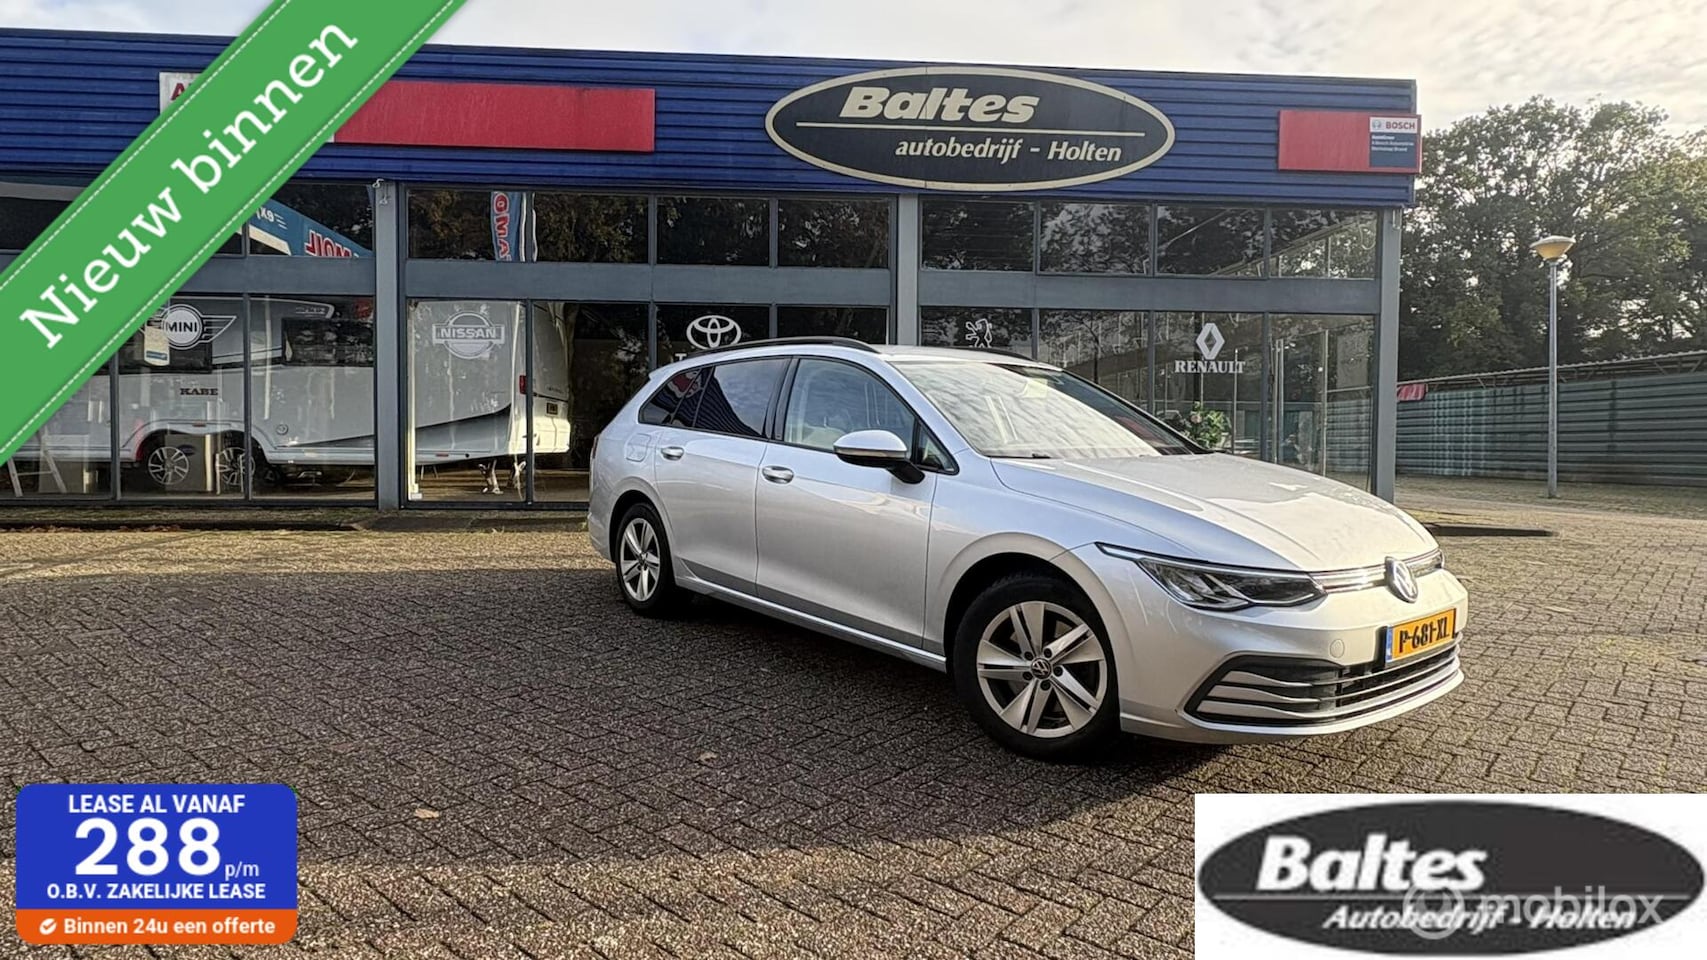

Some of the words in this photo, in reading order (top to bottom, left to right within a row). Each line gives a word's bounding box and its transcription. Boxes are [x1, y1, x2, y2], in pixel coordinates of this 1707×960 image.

[839, 87, 1040, 123] Baltes
[1385, 121, 1415, 130] BOSCH
[895, 136, 1024, 164] autobedrijf
[1047, 140, 1122, 162] Holten
[166, 322, 197, 332] MINI
[441, 328, 496, 338] NISSAN
[1174, 360, 1245, 374] RENAULT
[180, 388, 218, 396] KABE
[1399, 616, 1450, 654] P-681-XL
